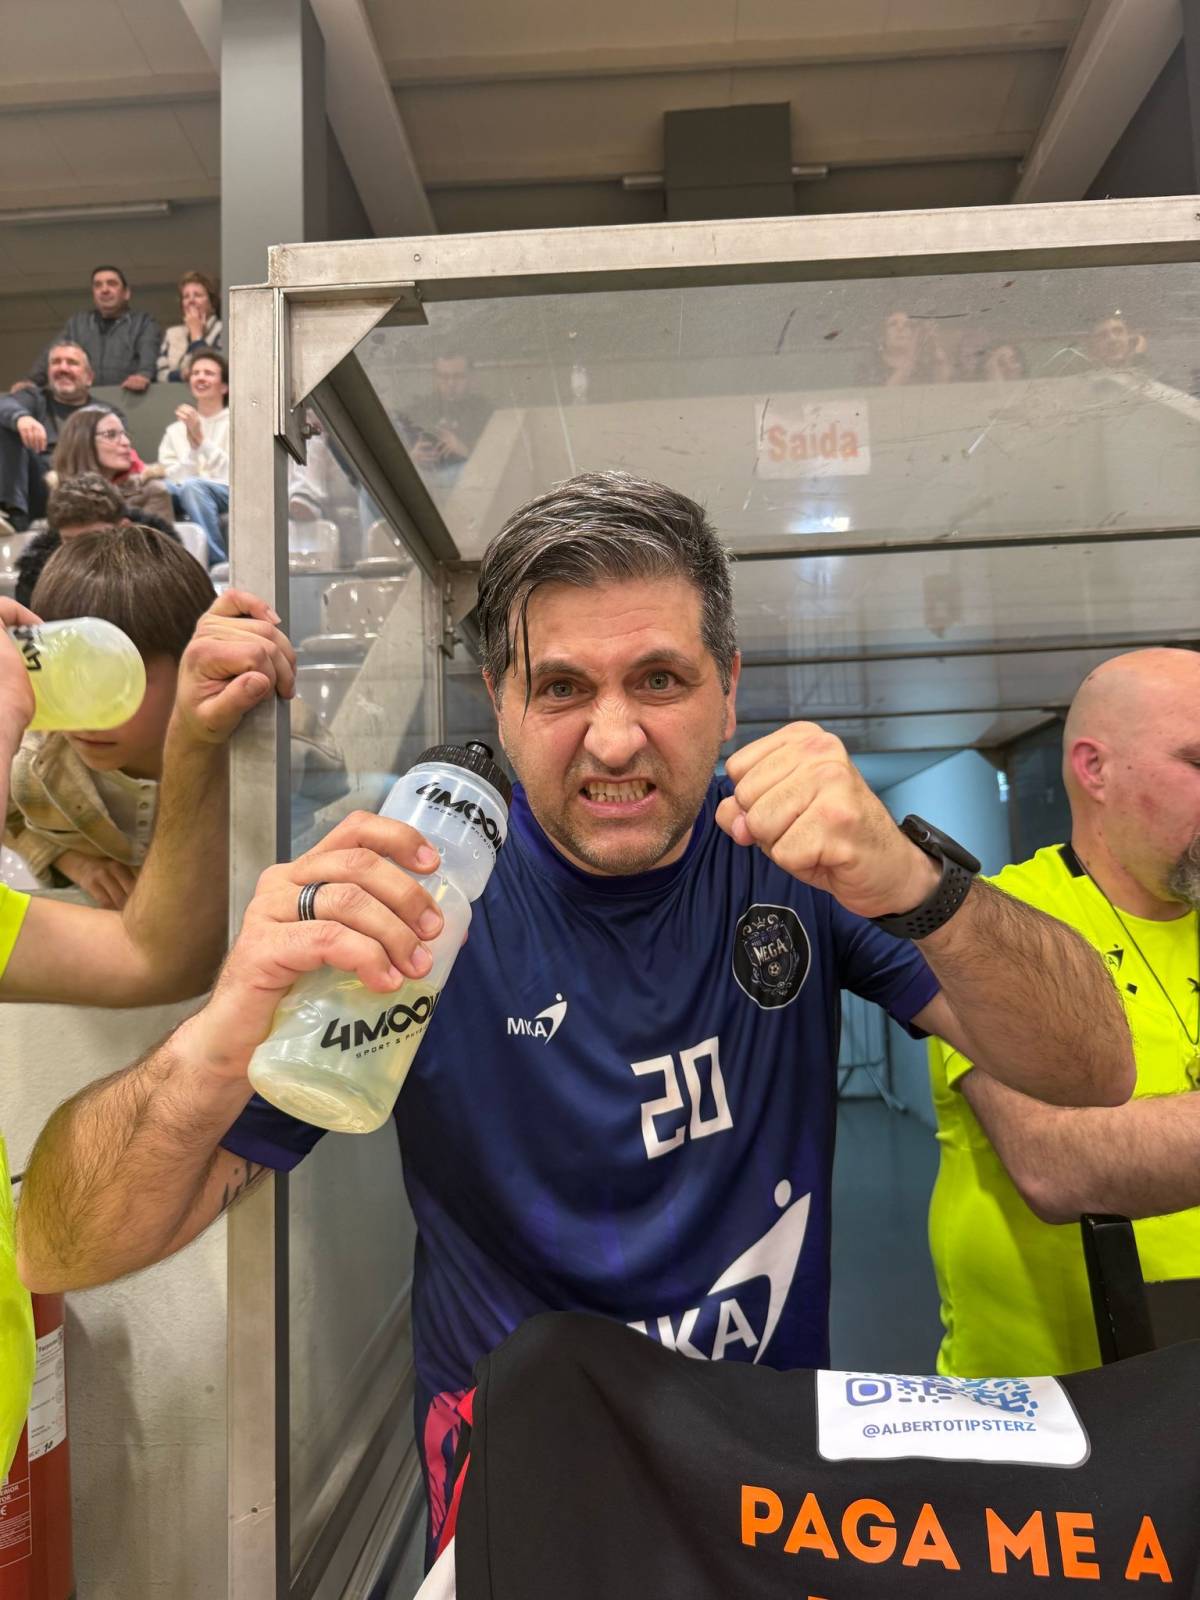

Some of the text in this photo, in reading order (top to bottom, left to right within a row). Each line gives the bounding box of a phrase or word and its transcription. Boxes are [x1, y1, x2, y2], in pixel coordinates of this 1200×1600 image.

[753, 938, 788, 965] MEGA
[507, 1017, 548, 1037] MKA
[355, 1041, 390, 1059] SPORT
[630, 1036, 734, 1160] 20
[626, 1298, 759, 1361] KA
[862, 1419, 1037, 1438] @ALBERTOTIPSTERZ
[741, 1485, 1173, 1583] PAGA ME A
